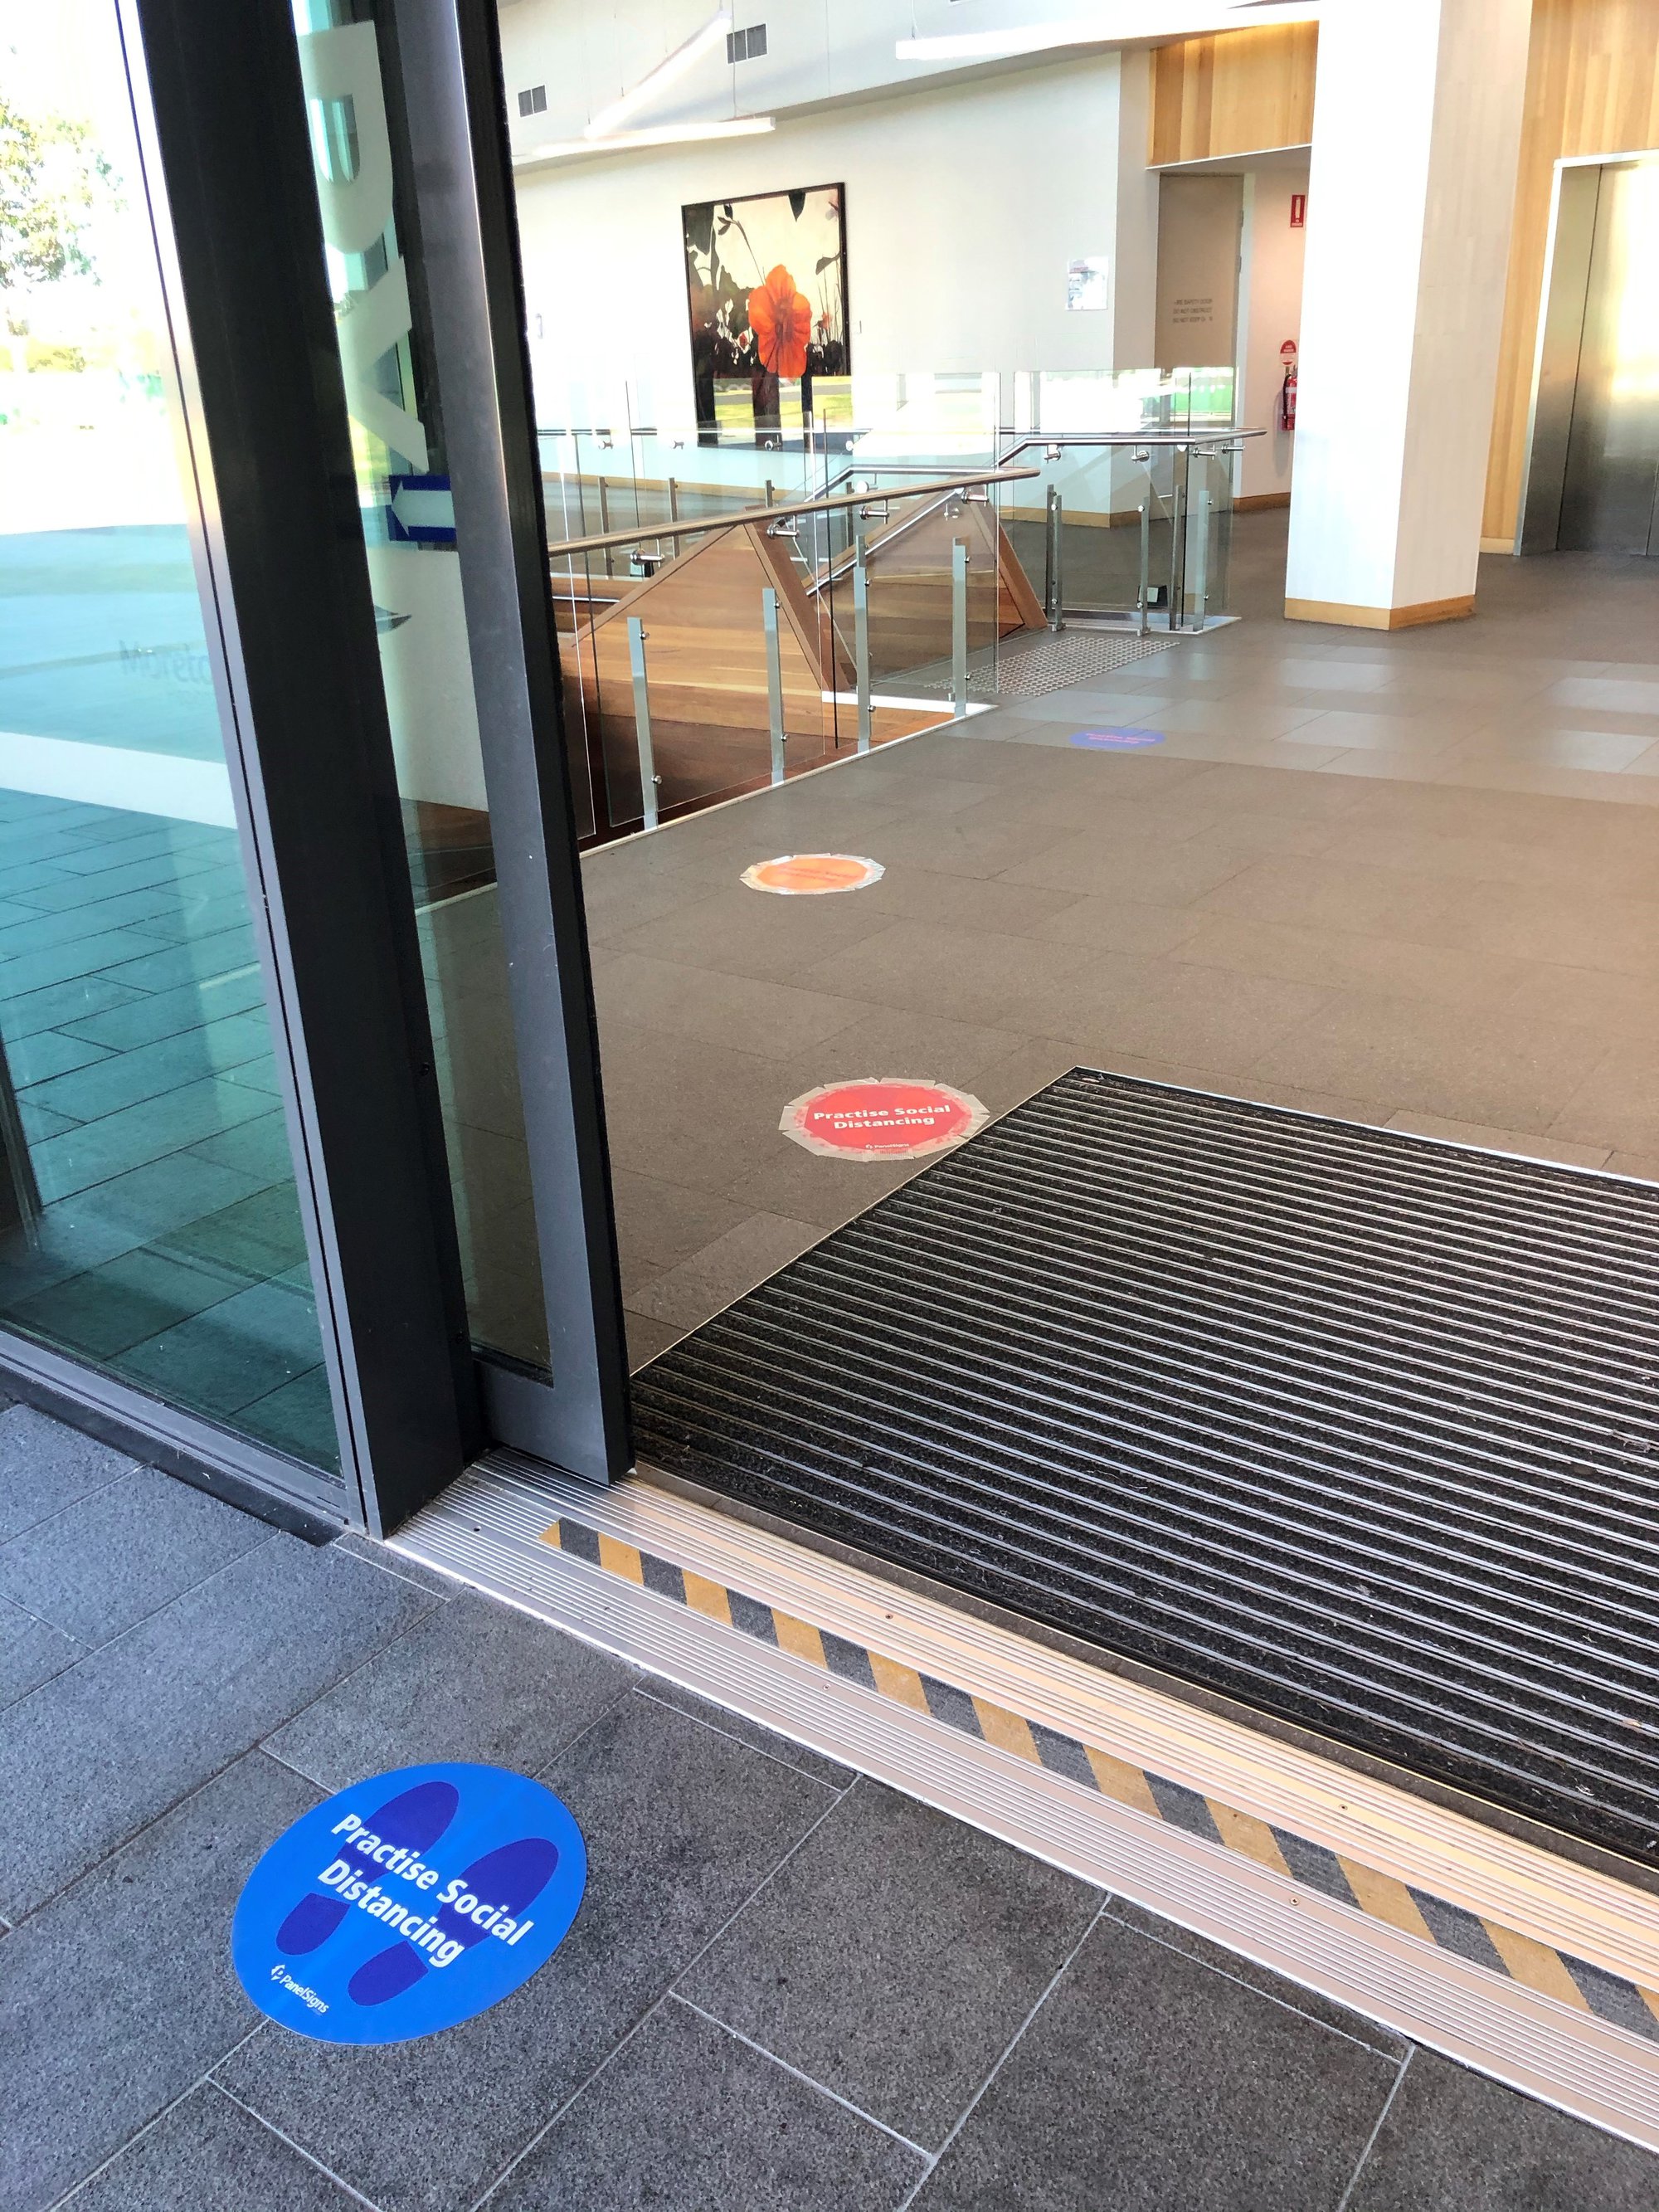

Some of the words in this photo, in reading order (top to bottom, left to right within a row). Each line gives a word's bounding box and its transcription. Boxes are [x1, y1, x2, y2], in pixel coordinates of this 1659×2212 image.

[813, 1109, 888, 1120] Practise
[893, 1104, 951, 1116] Social
[834, 1115, 935, 1129] Distancing
[331, 1813, 440, 1891] Practise
[436, 1878, 533, 1946] Social
[317, 1859, 466, 1968] Distancing
[279, 1974, 329, 2013] PanelSigns
